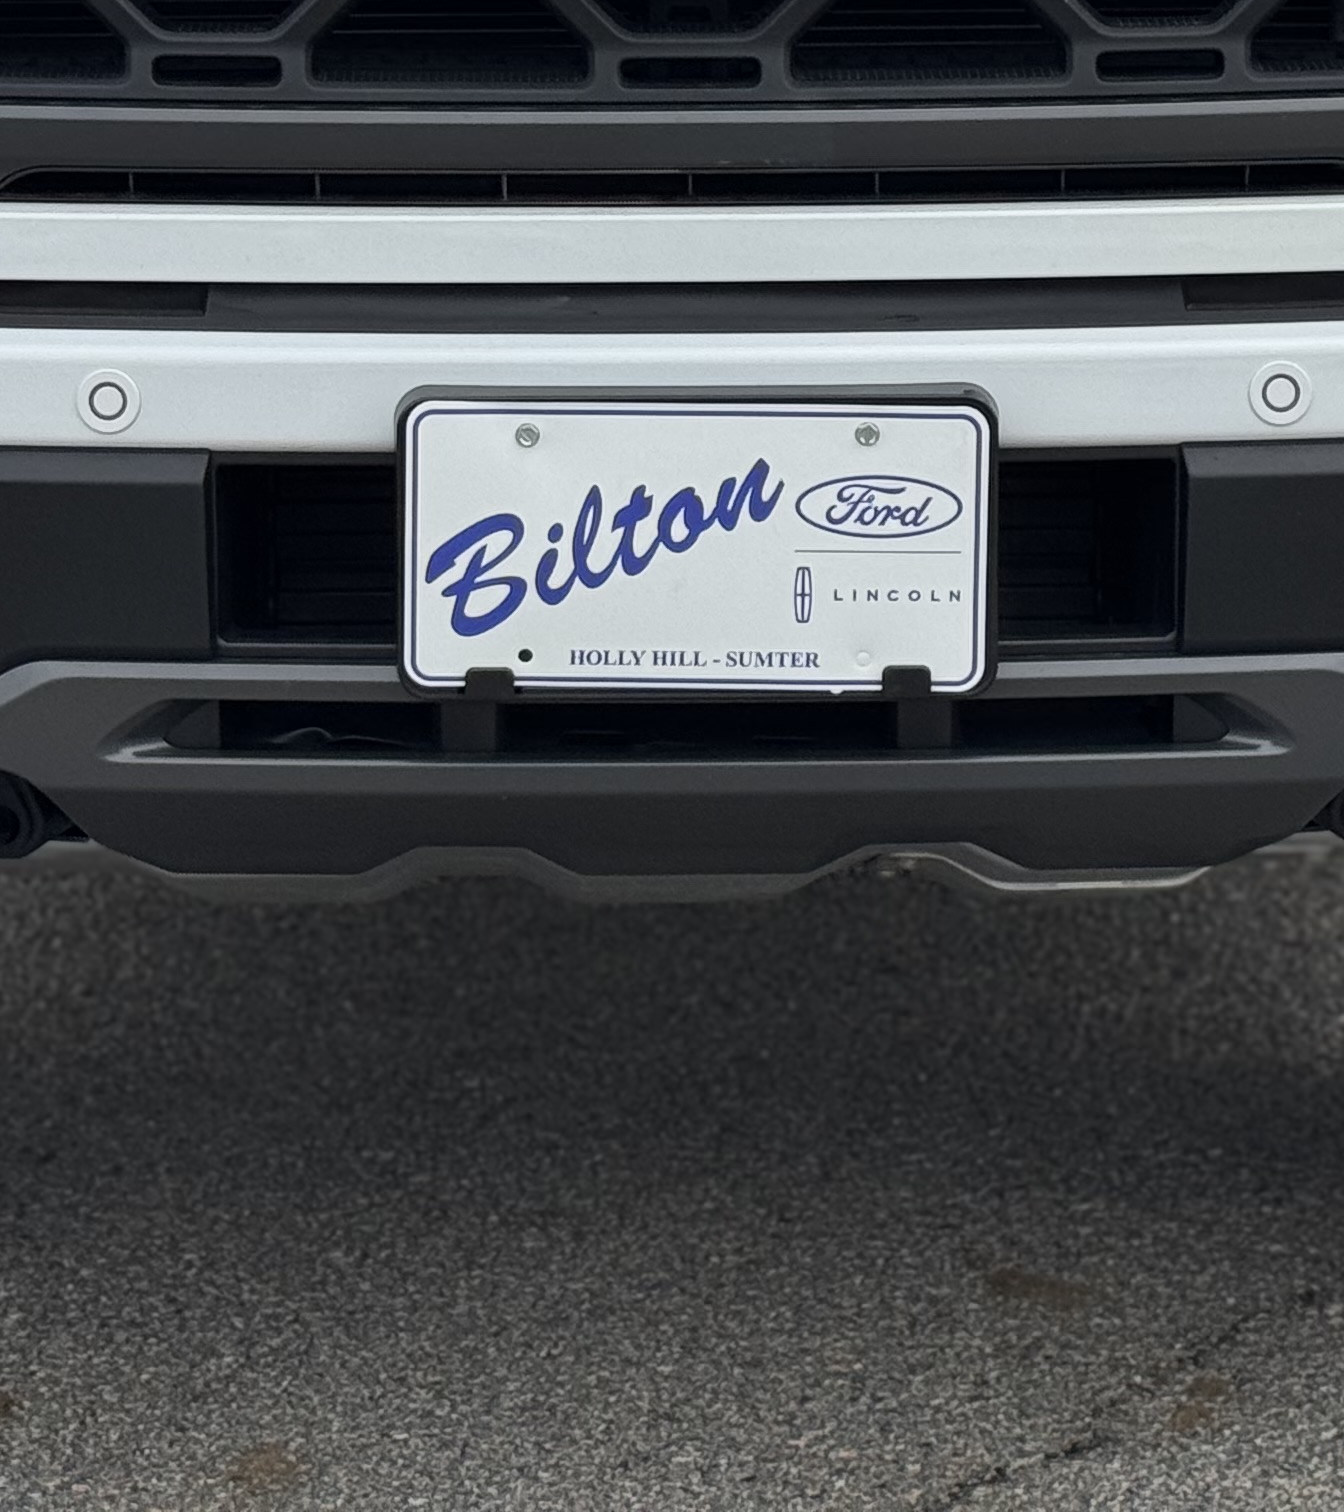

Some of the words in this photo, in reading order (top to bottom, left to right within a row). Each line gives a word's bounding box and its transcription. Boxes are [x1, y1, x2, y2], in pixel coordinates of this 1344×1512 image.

[824, 484, 933, 528] Ford
[424, 456, 786, 638] Bilton
[832, 588, 963, 603] LINCOLN
[568, 648, 647, 668] HOLLY
[651, 649, 709, 669] HILL
[724, 650, 821, 670] SUMTER
